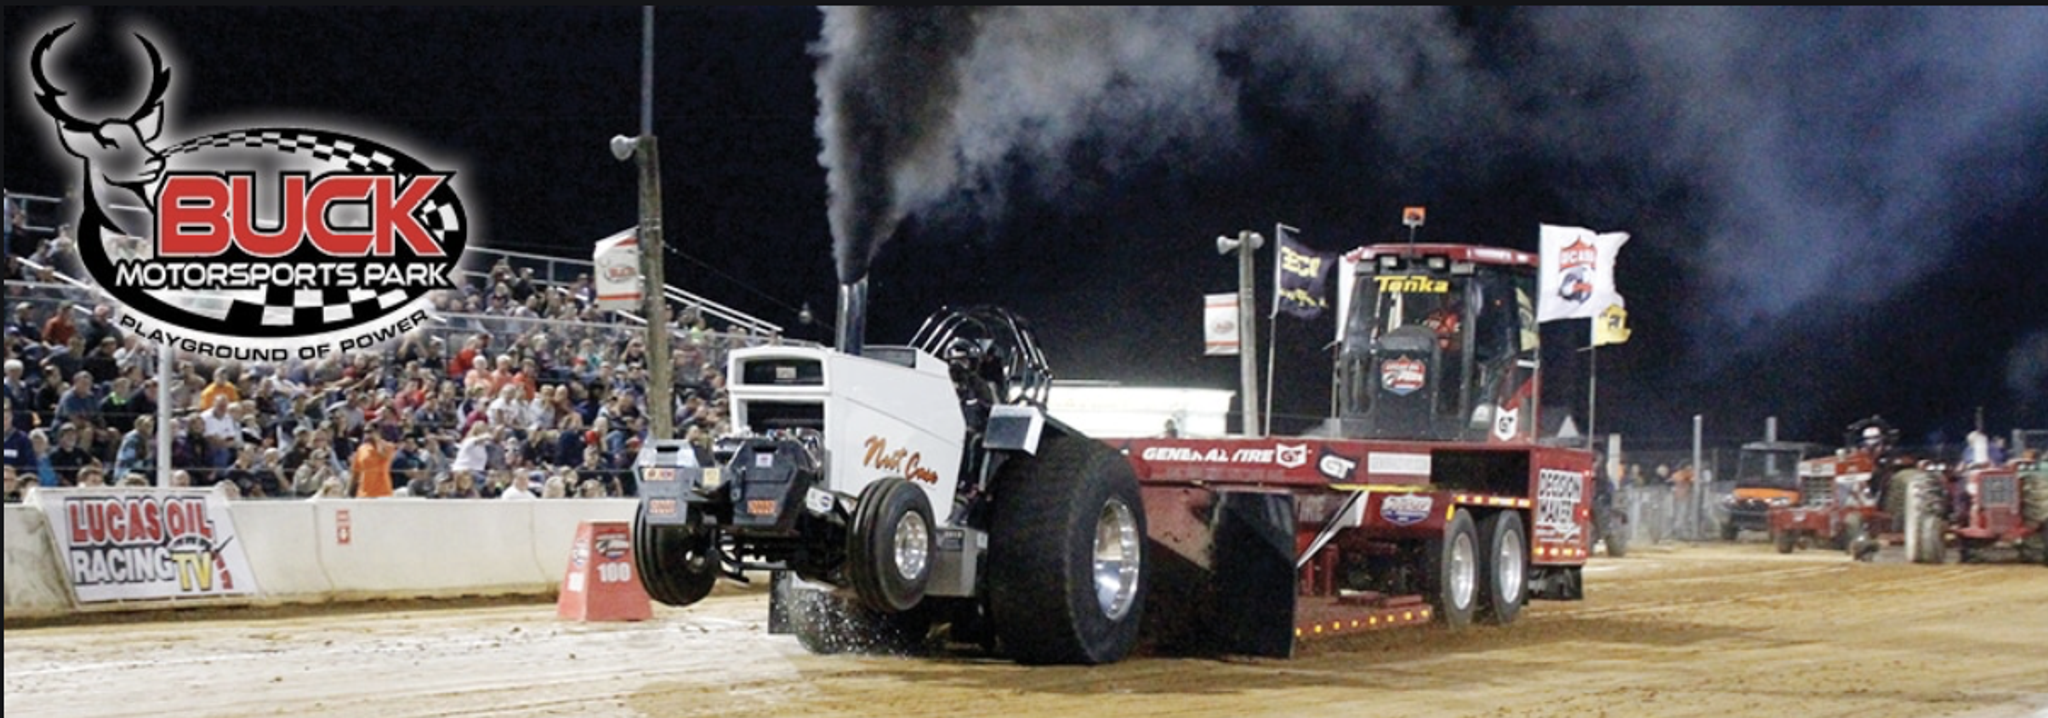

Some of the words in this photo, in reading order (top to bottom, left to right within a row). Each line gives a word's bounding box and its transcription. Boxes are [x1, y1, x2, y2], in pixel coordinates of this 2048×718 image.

[1373, 275, 1449, 293] Tonka
[1142, 447, 1230, 462] GENERAL
[1319, 454, 1357, 479] GT
[67, 500, 164, 545] LUCAS
[164, 499, 215, 539] OIL
[72, 547, 175, 585] RACING
[172, 551, 213, 592] TV
[596, 561, 632, 583] 100
